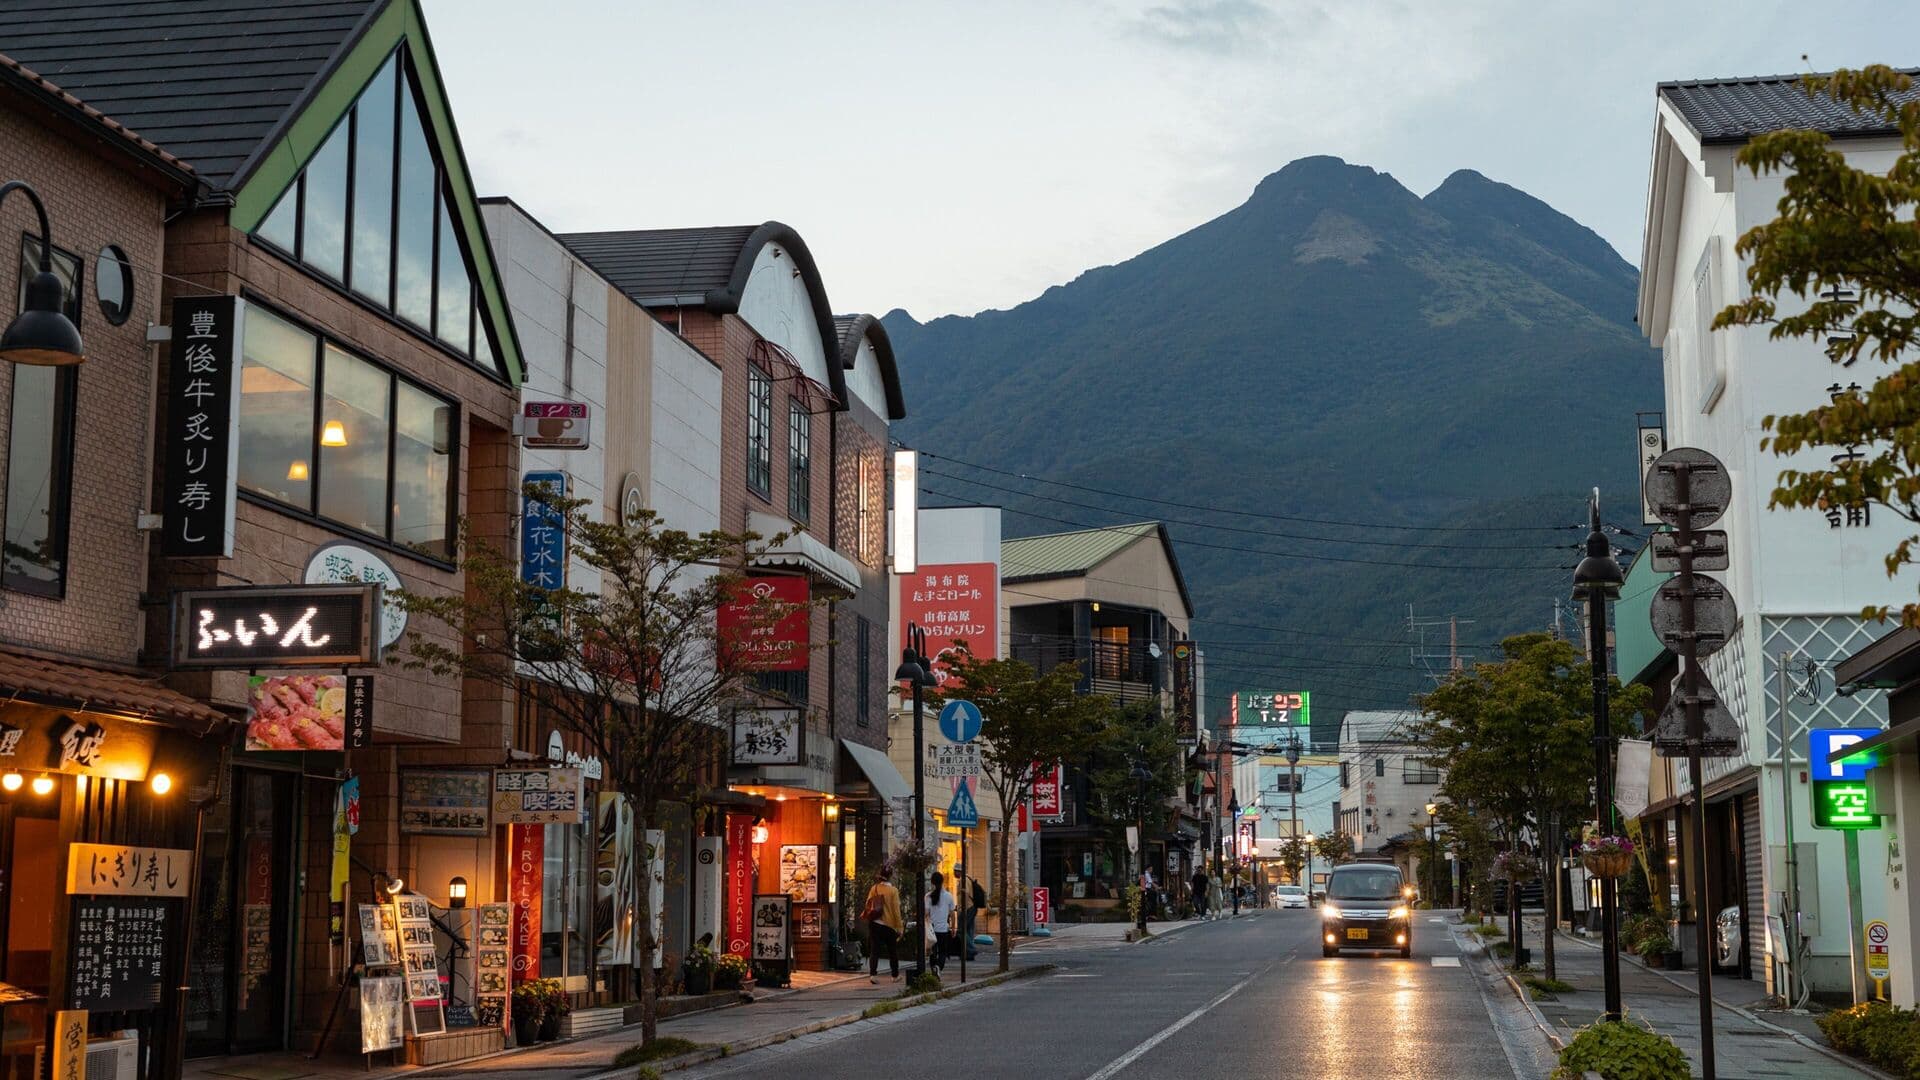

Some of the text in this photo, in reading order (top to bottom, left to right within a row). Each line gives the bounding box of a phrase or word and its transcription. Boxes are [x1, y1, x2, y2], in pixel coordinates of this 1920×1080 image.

[178, 310, 219, 542] 豊後牛炙り寿し
[529, 526, 556, 587] 花水木
[912, 589, 982, 602] たまごロール
[926, 575, 969, 587] 湯布院
[198, 607, 331, 649] ふいん
[924, 610, 970, 623] 由布高原
[352, 678, 365, 747] 豊後牛炙り寿し
[1247, 693, 1303, 709] パチンコ
[1260, 710, 1288, 722] T.Z
[1829, 735, 1864, 776] P
[496, 772, 549, 791] 軽食
[511, 813, 560, 822] 花水木
[523, 791, 575, 811] 喫茶
[1829, 786, 1873, 823] 空
[91, 851, 178, 891] にぎり寿し
[519, 850, 533, 946] ROLLCAKE
[736, 860, 745, 933] ROLLCAKE
[1034, 890, 1045, 921] くすり
